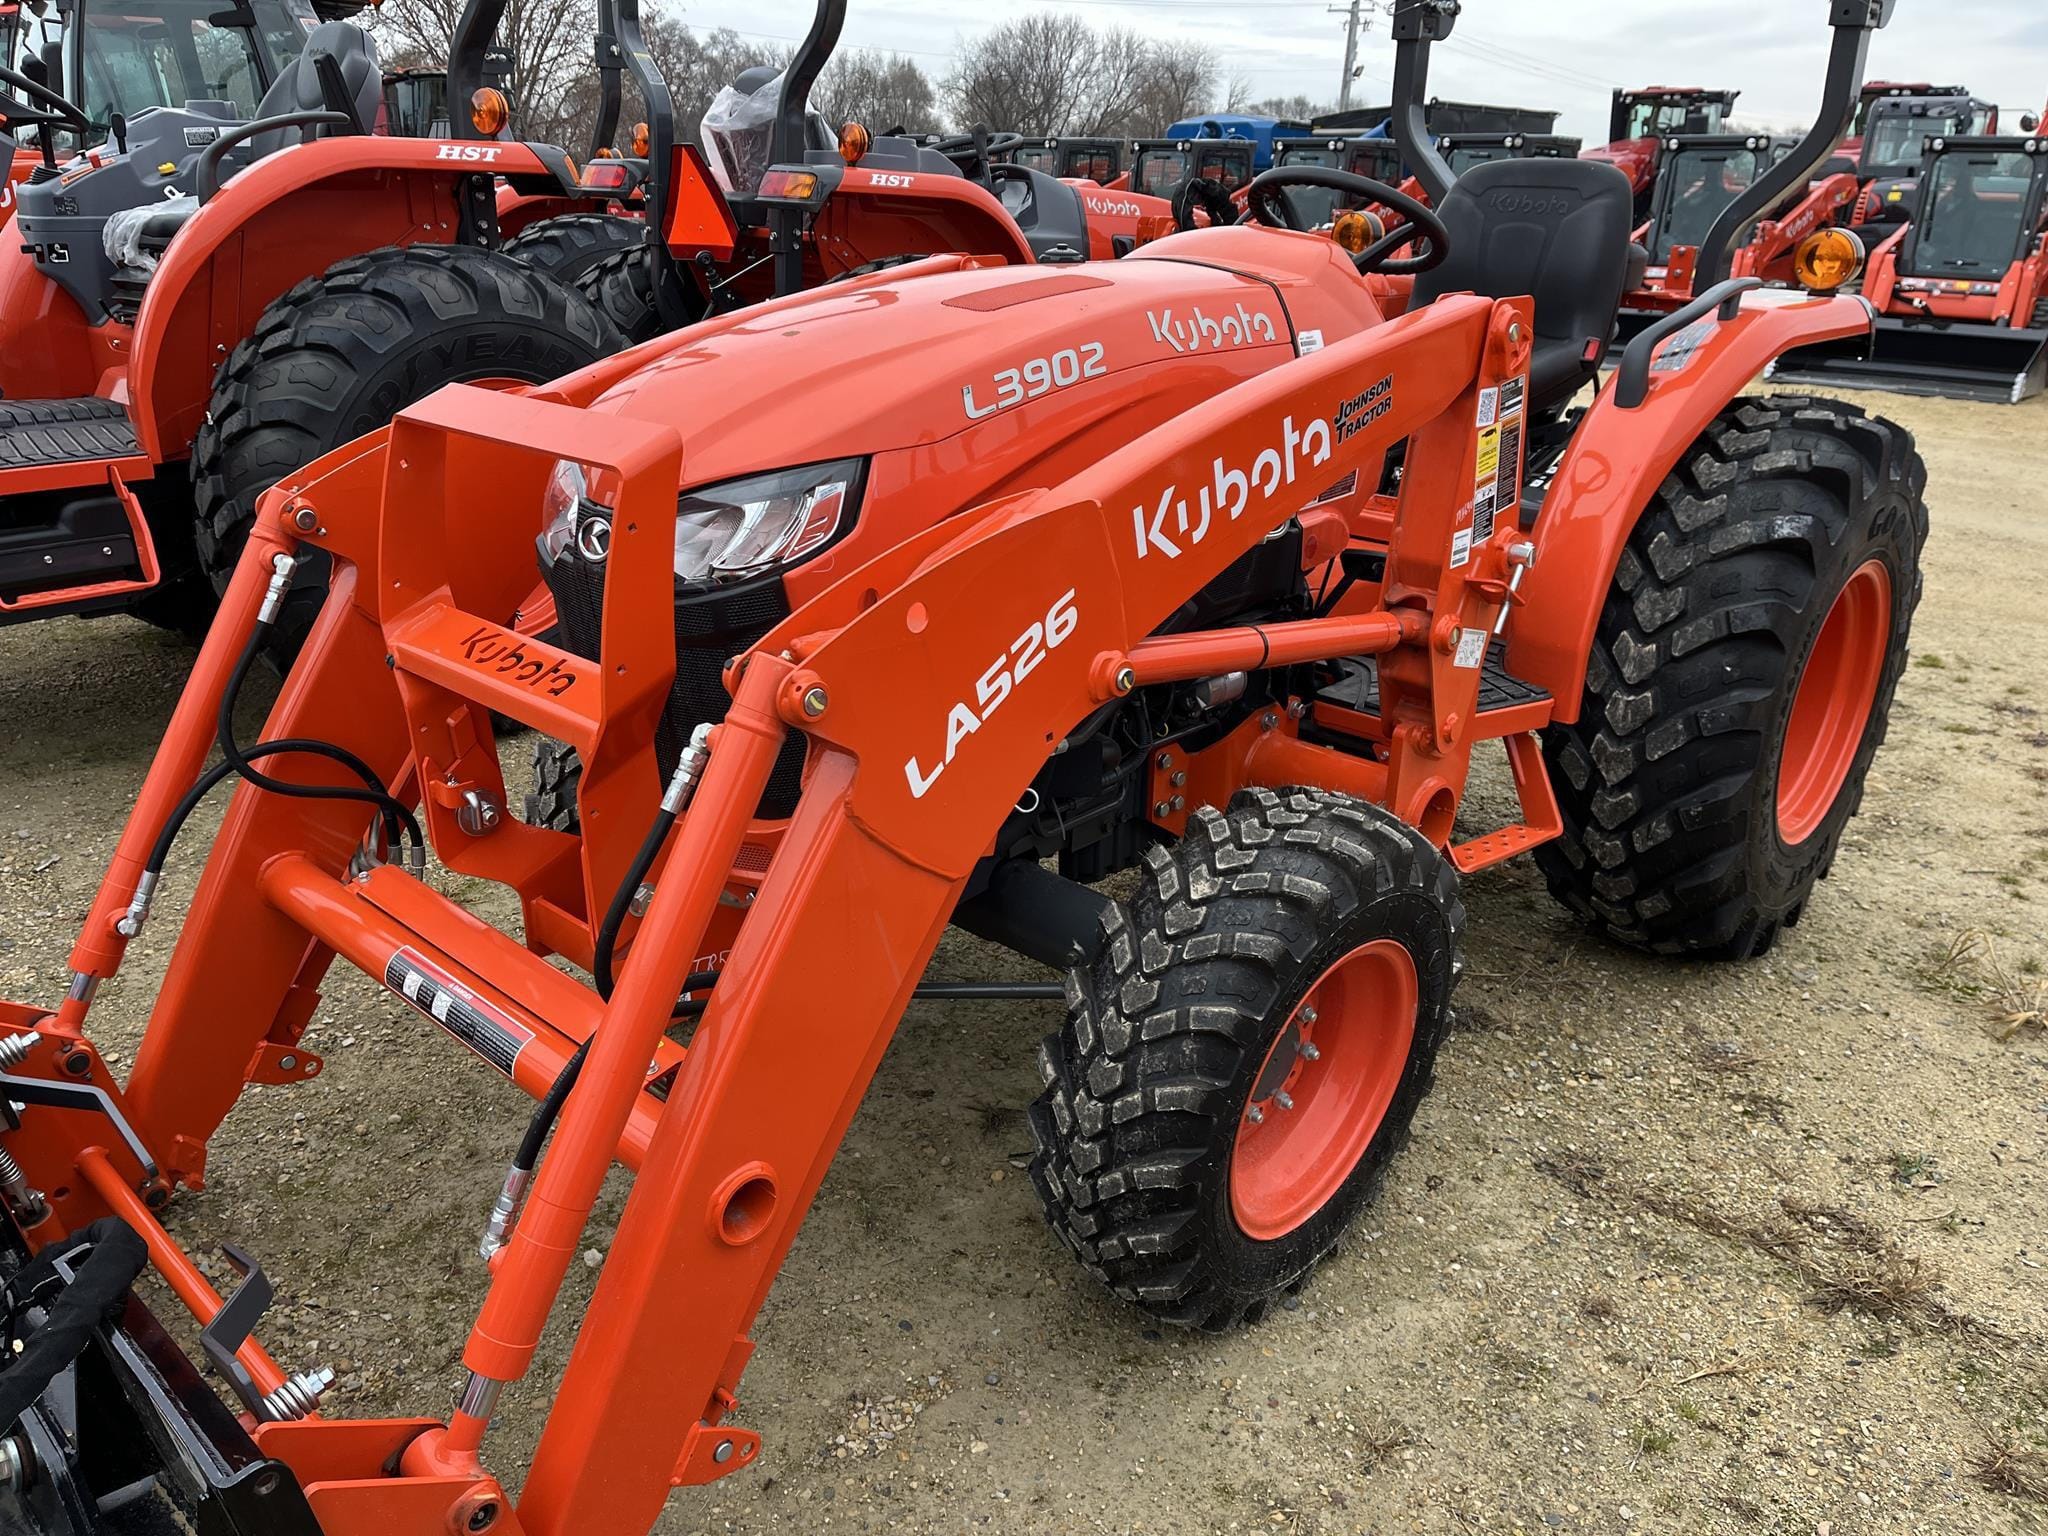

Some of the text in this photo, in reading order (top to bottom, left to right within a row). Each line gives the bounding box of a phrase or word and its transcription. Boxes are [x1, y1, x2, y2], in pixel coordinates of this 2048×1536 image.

[436, 144, 502, 162] HST
[869, 173, 914, 188] HST
[1489, 193, 1569, 215] Kubota
[1086, 196, 1140, 216] Kubota
[1146, 302, 1275, 352] Kubota
[962, 341, 1107, 420] L3902
[1334, 375, 1393, 426] JOHNSON
[1336, 396, 1392, 444] TRACTOR
[1133, 413, 1332, 559] Kubota
[460, 627, 577, 697] Kubota
[904, 587, 1079, 799] LA526
